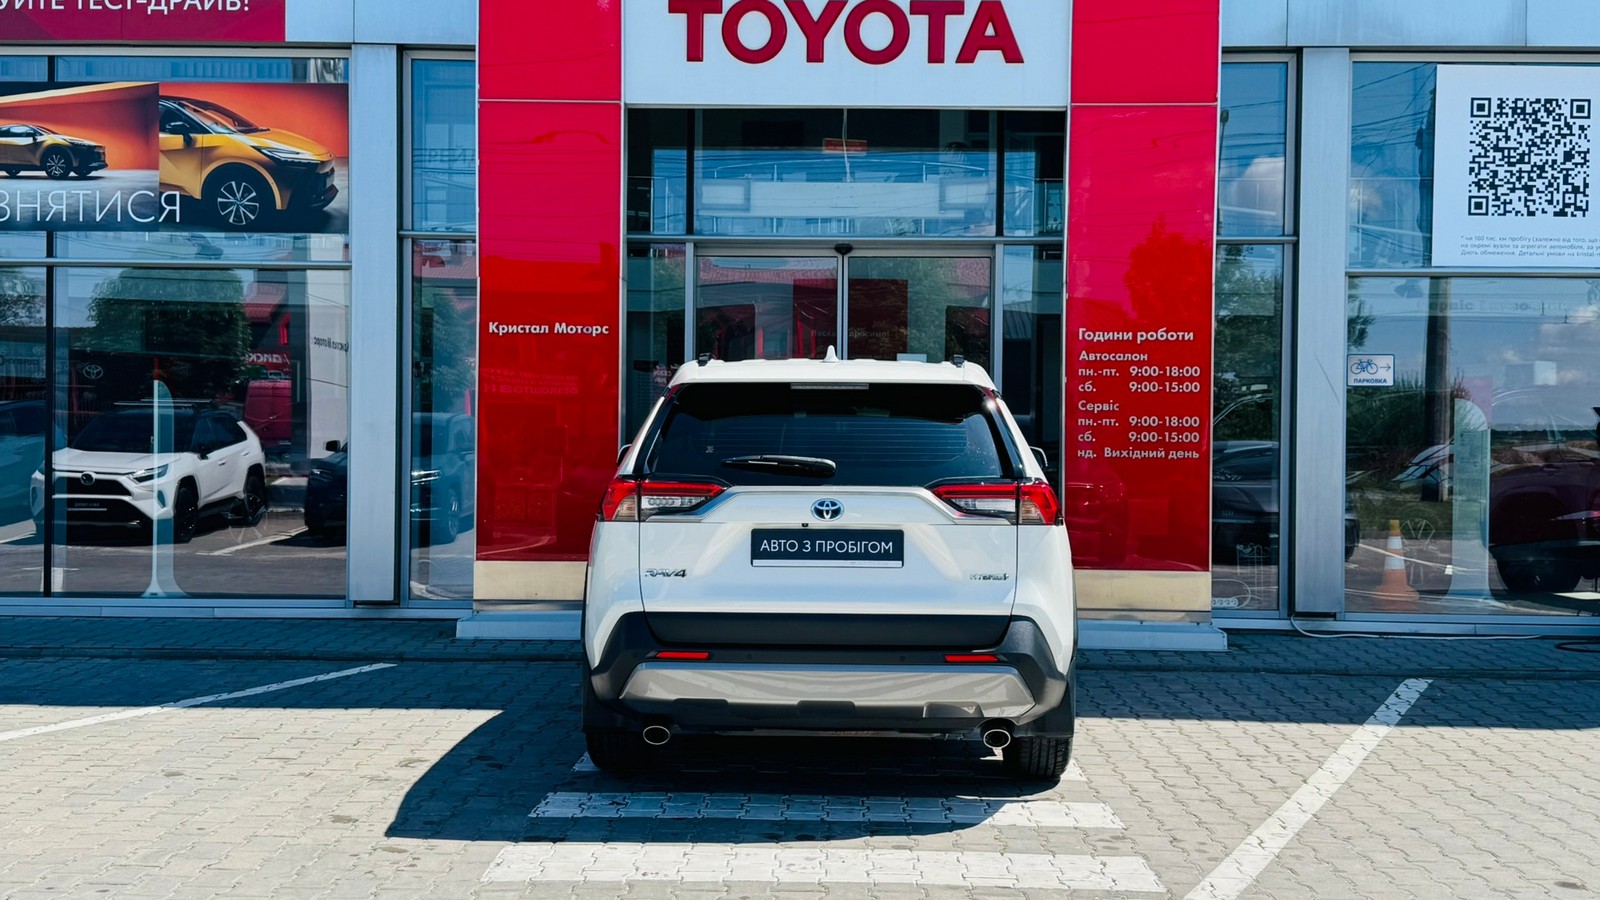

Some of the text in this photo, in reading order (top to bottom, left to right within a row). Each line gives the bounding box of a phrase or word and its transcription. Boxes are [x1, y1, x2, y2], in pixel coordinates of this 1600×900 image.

[668, 0, 1024, 64] TOYOTA
[489, 322, 609, 336] Кристал Моторс
[1078, 327, 1194, 344] Години роботи
[1079, 350, 1148, 361] Автосалон
[1078, 366, 1200, 377] пн.-пт. 9:00-18:00
[1078, 381, 1200, 393] сб. 9:00-15:00
[1078, 400, 1120, 413] Сервіс
[1078, 416, 1200, 427] пн.-пт. 9:00-18:00
[1078, 431, 1200, 443] сб. 9:00-15:00
[1078, 447, 1200, 459] нд. Вихідний день
[760, 540, 893, 554] АВТО З ПРОБІГОМ
